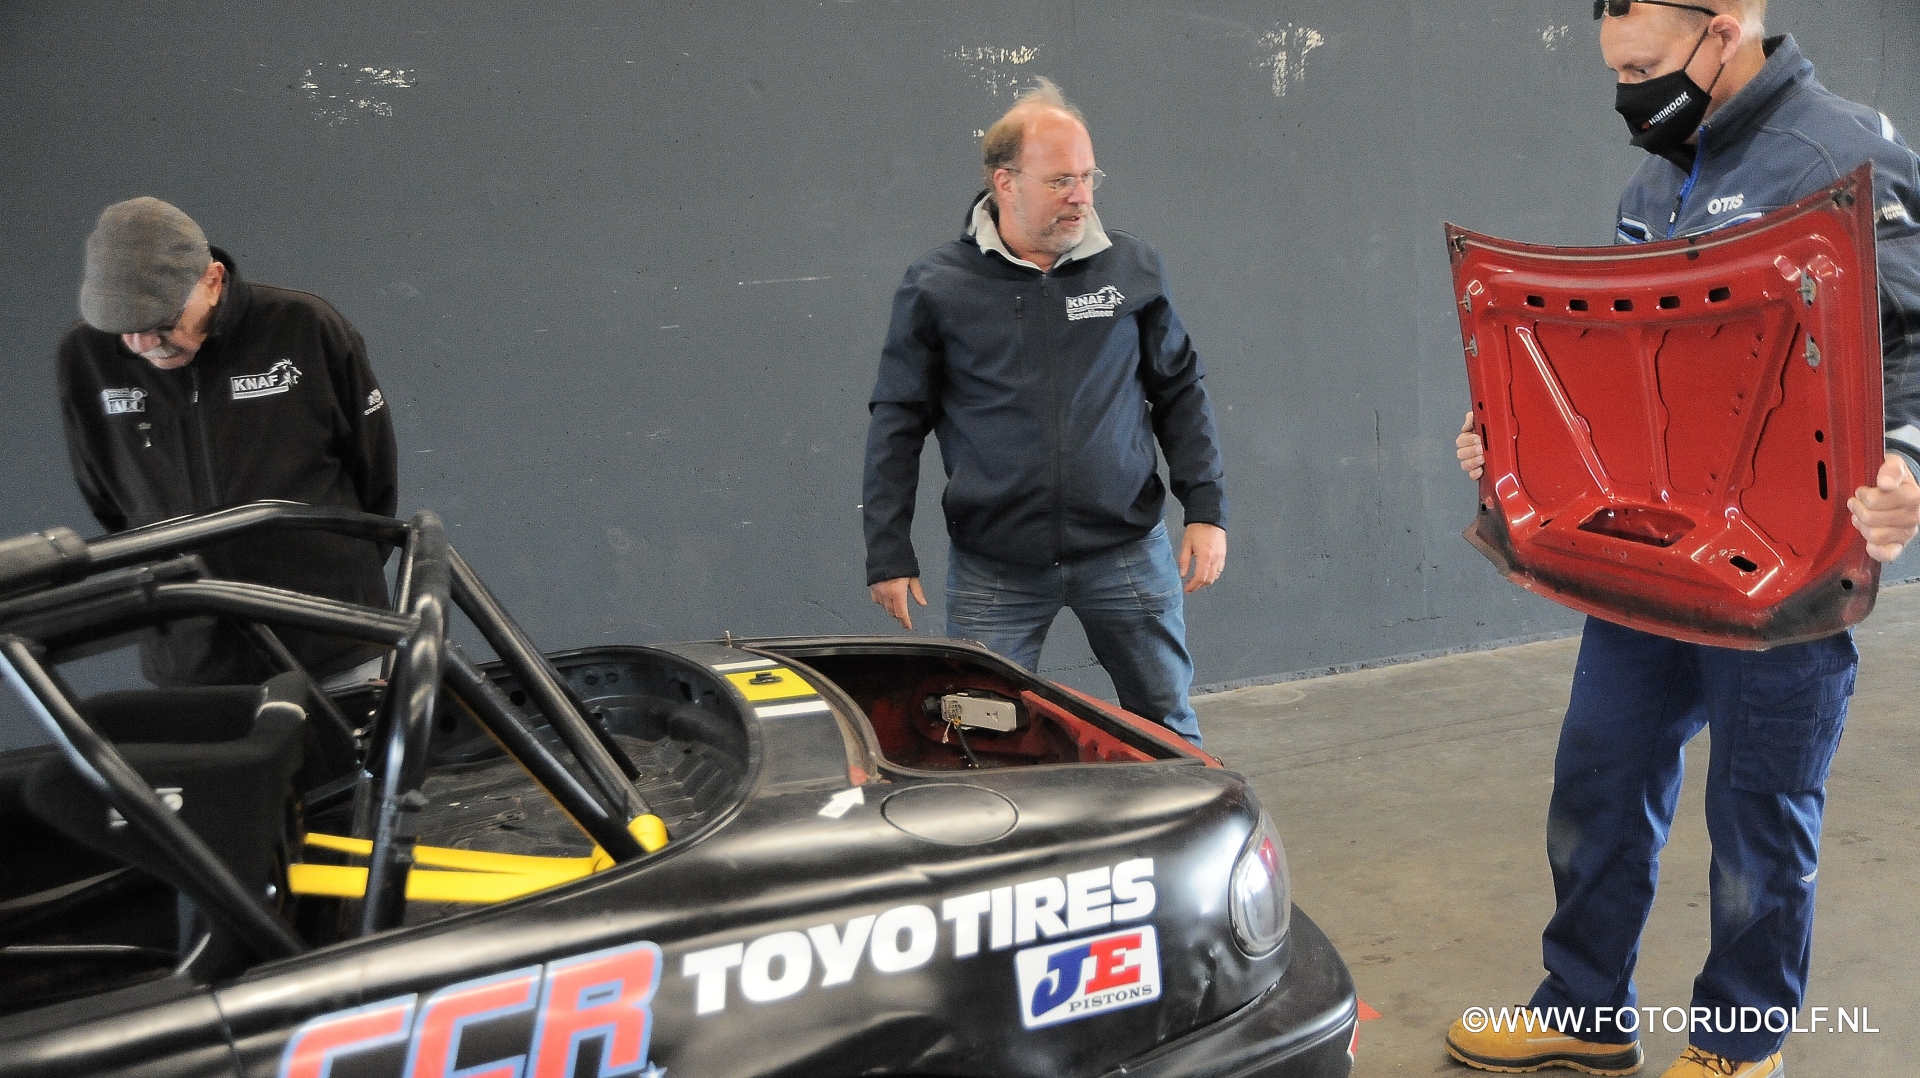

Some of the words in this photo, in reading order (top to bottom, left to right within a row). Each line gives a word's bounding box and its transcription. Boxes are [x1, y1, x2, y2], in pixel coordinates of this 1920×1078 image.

[1707, 193, 1744, 215] OTIS
[1068, 295, 1106, 308] KNAF
[233, 375, 279, 391] KNAF
[681, 904, 938, 1015] TOYO
[941, 857, 1156, 958] TIRES
[1031, 931, 1143, 1018] JE
[1068, 983, 1154, 1014] PISTONS
